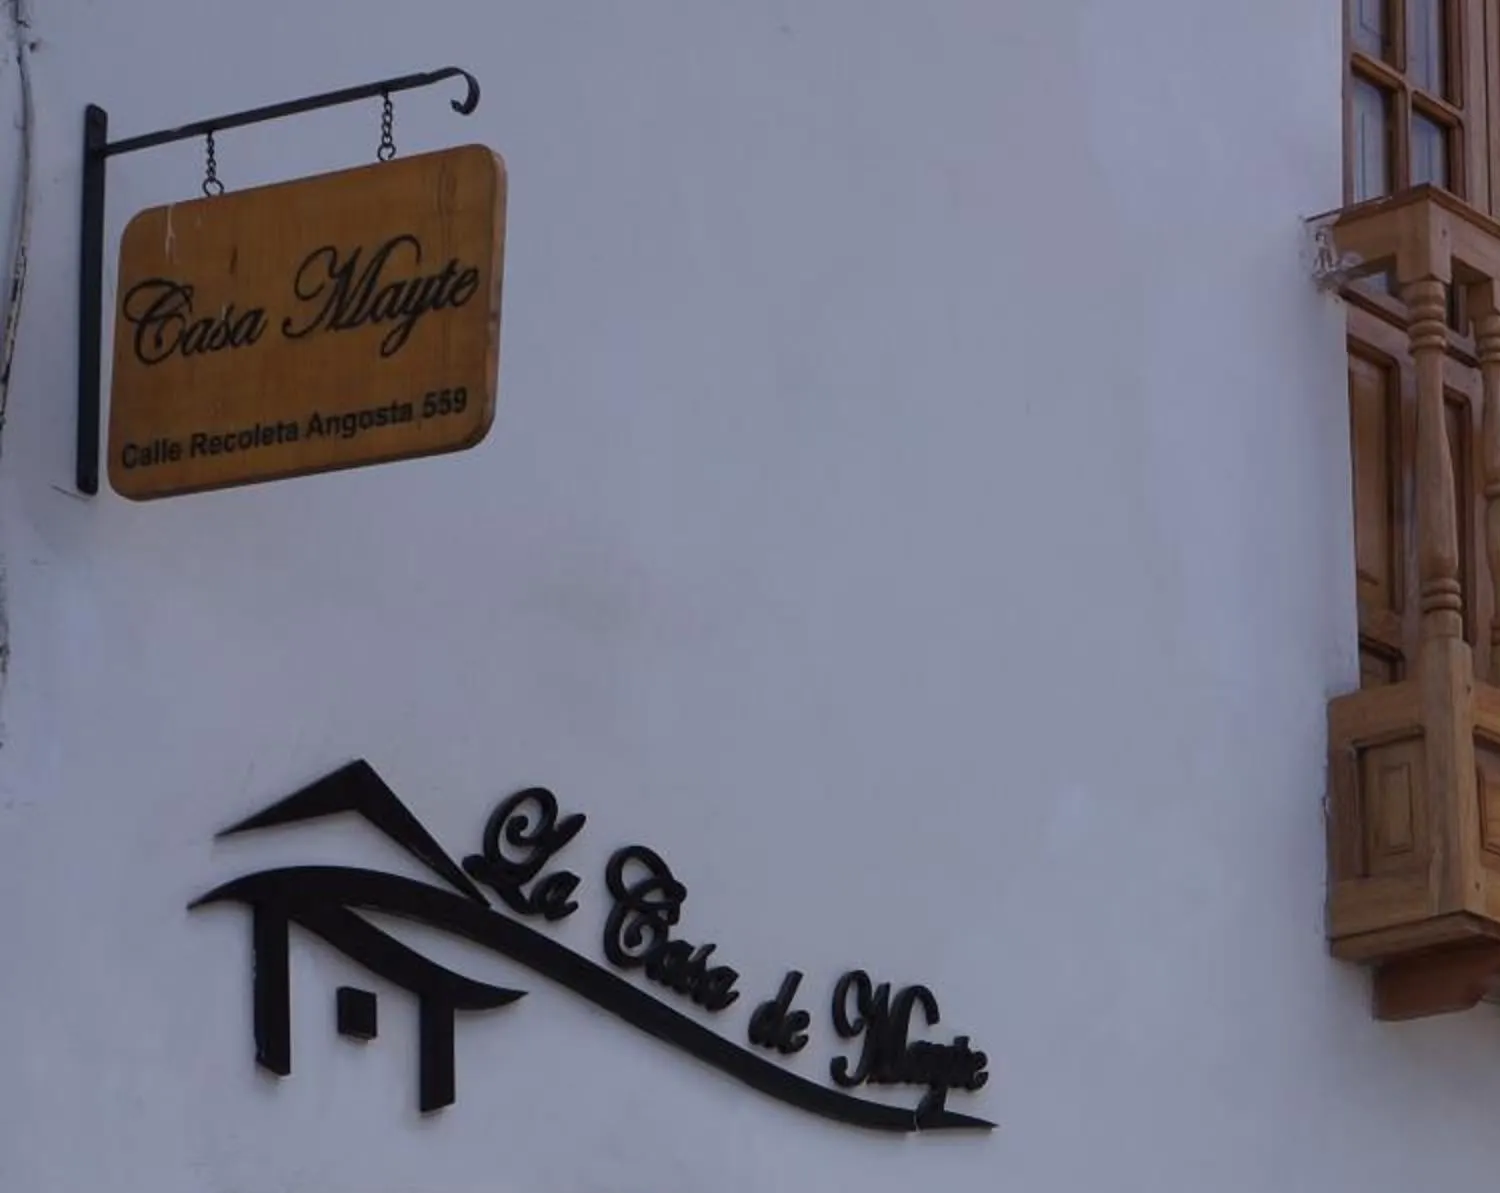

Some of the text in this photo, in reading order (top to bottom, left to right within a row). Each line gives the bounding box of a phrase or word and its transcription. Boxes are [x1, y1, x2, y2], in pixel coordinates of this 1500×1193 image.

[122, 233, 480, 366] Casa Mayte
[121, 386, 468, 470] Calle Recoleta Angosta 559
[462, 787, 587, 921] La
[748, 970, 811, 1055] de
